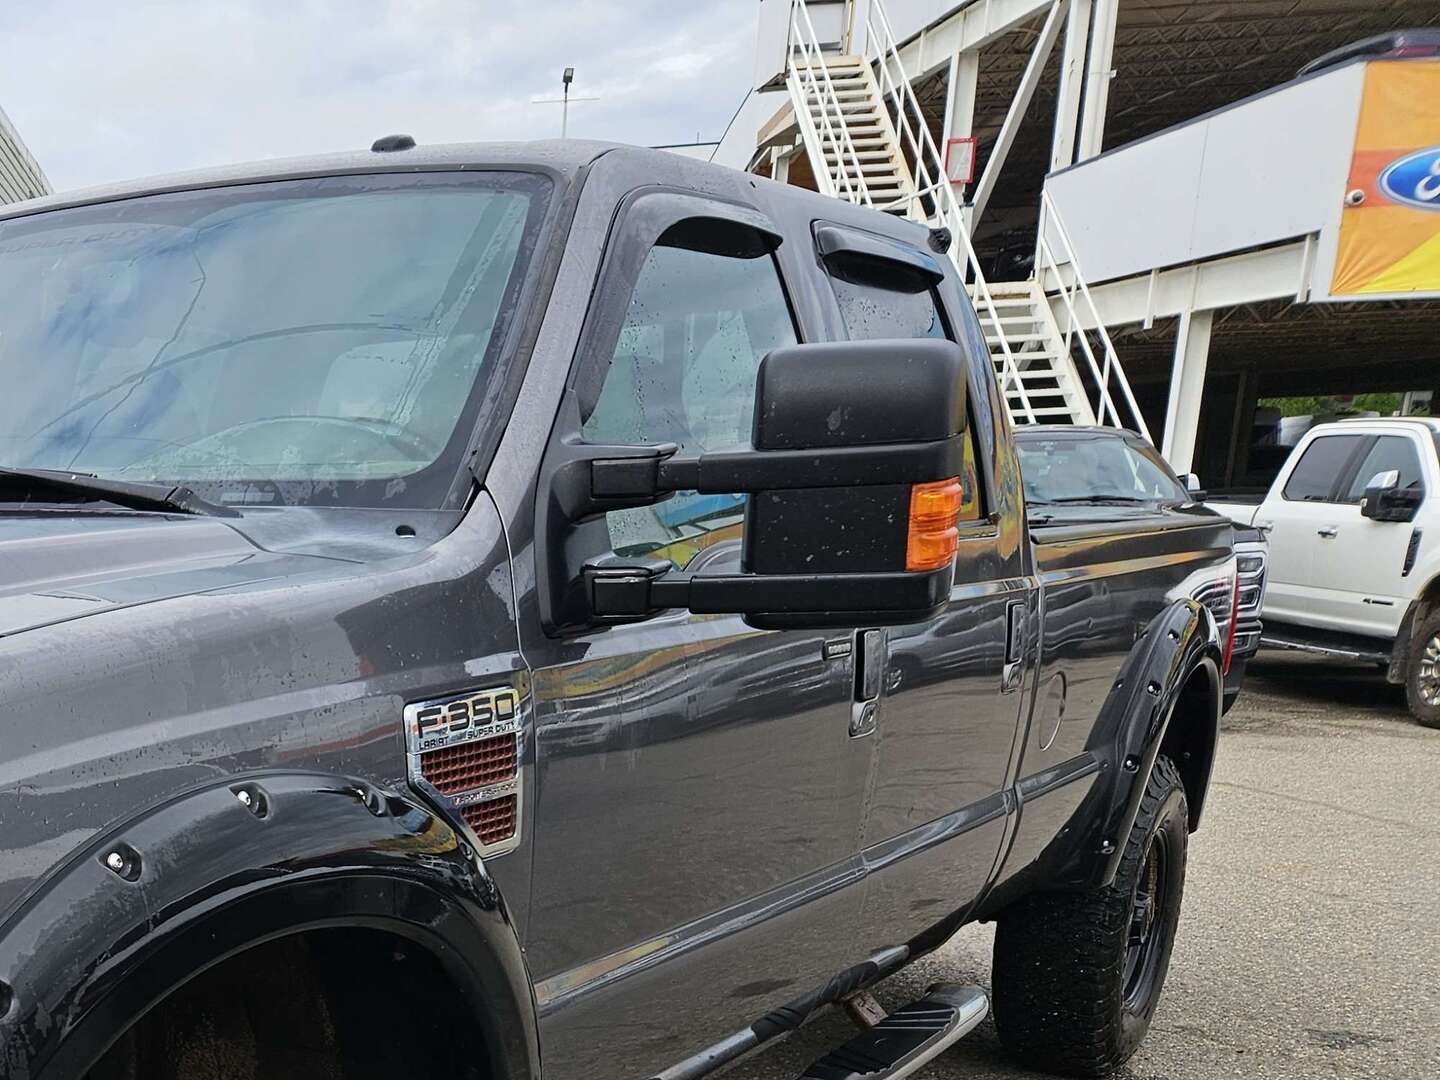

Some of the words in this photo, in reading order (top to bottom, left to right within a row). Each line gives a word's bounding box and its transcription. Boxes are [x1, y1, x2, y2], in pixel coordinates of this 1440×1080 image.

[417, 692, 515, 739] F-350
[467, 726, 494, 739] SUPER
[495, 721, 517, 733] DUTY
